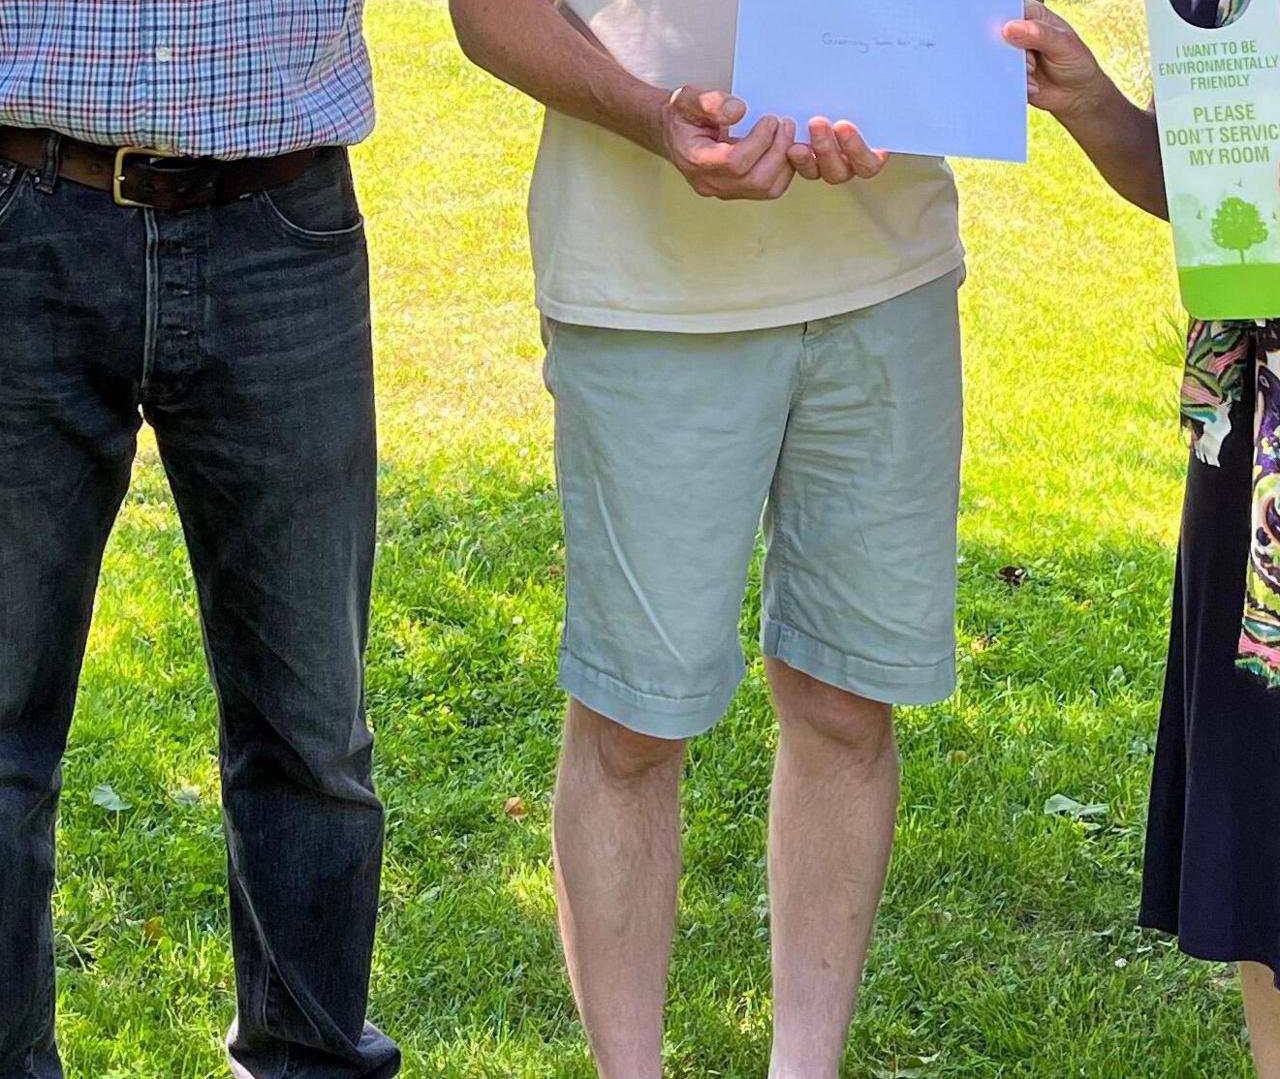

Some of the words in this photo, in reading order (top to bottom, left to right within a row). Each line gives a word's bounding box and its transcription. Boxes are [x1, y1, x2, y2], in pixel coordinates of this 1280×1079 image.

[1176, 44, 1180, 58] I
[1182, 42, 1217, 58] WANT
[1221, 41, 1238, 55] TO
[1241, 40, 1257, 54] BE
[1158, 55, 1279, 75] ENVIRONMENTALLY
[1190, 74, 1250, 90] FRIENDLY
[1193, 103, 1255, 123] PLEASE
[1165, 127, 1215, 146] DON'T
[1189, 148, 1214, 166] MY
[1219, 146, 1270, 164] ROOM
